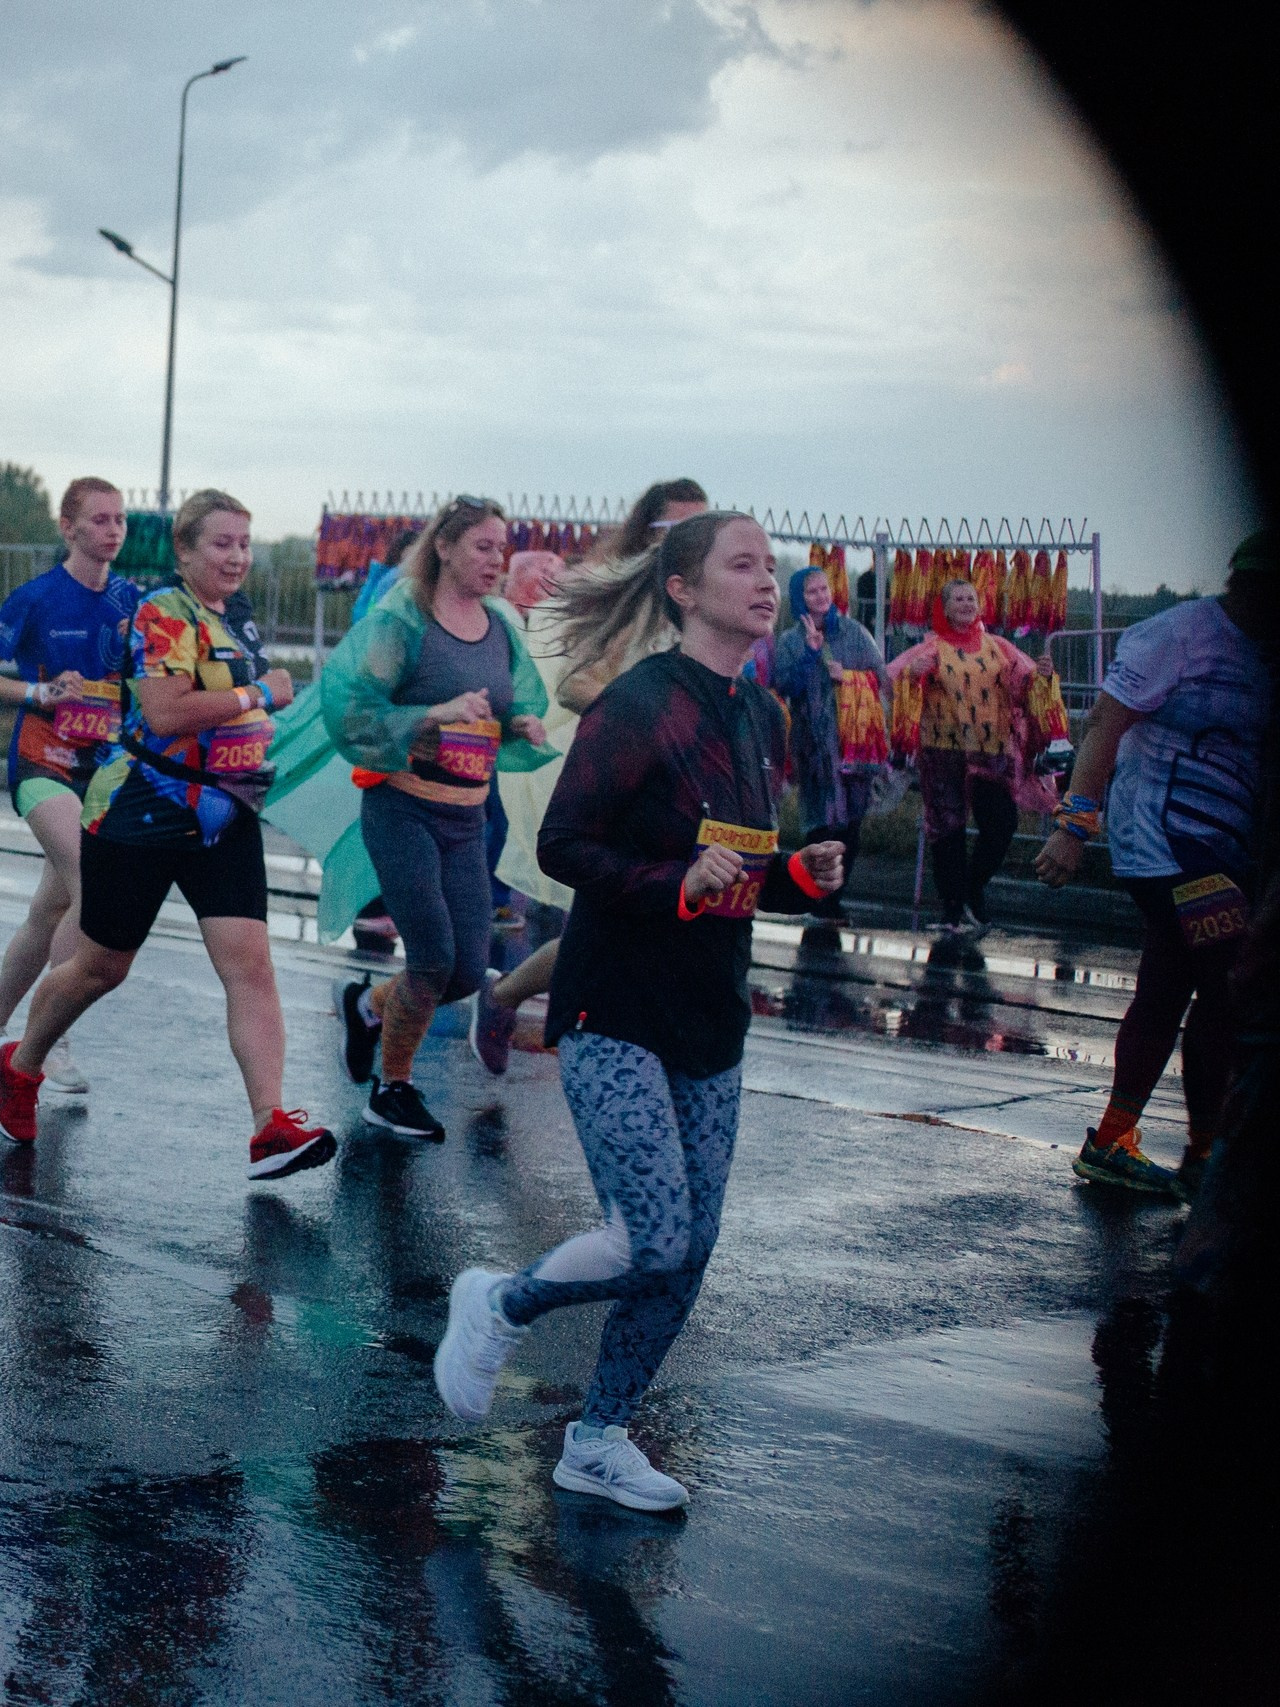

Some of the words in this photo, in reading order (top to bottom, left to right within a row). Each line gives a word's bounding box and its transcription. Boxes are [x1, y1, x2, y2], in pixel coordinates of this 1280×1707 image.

[58, 709, 108, 736] 2476
[213, 741, 264, 768] 2058
[1189, 908, 1244, 945] 2033
